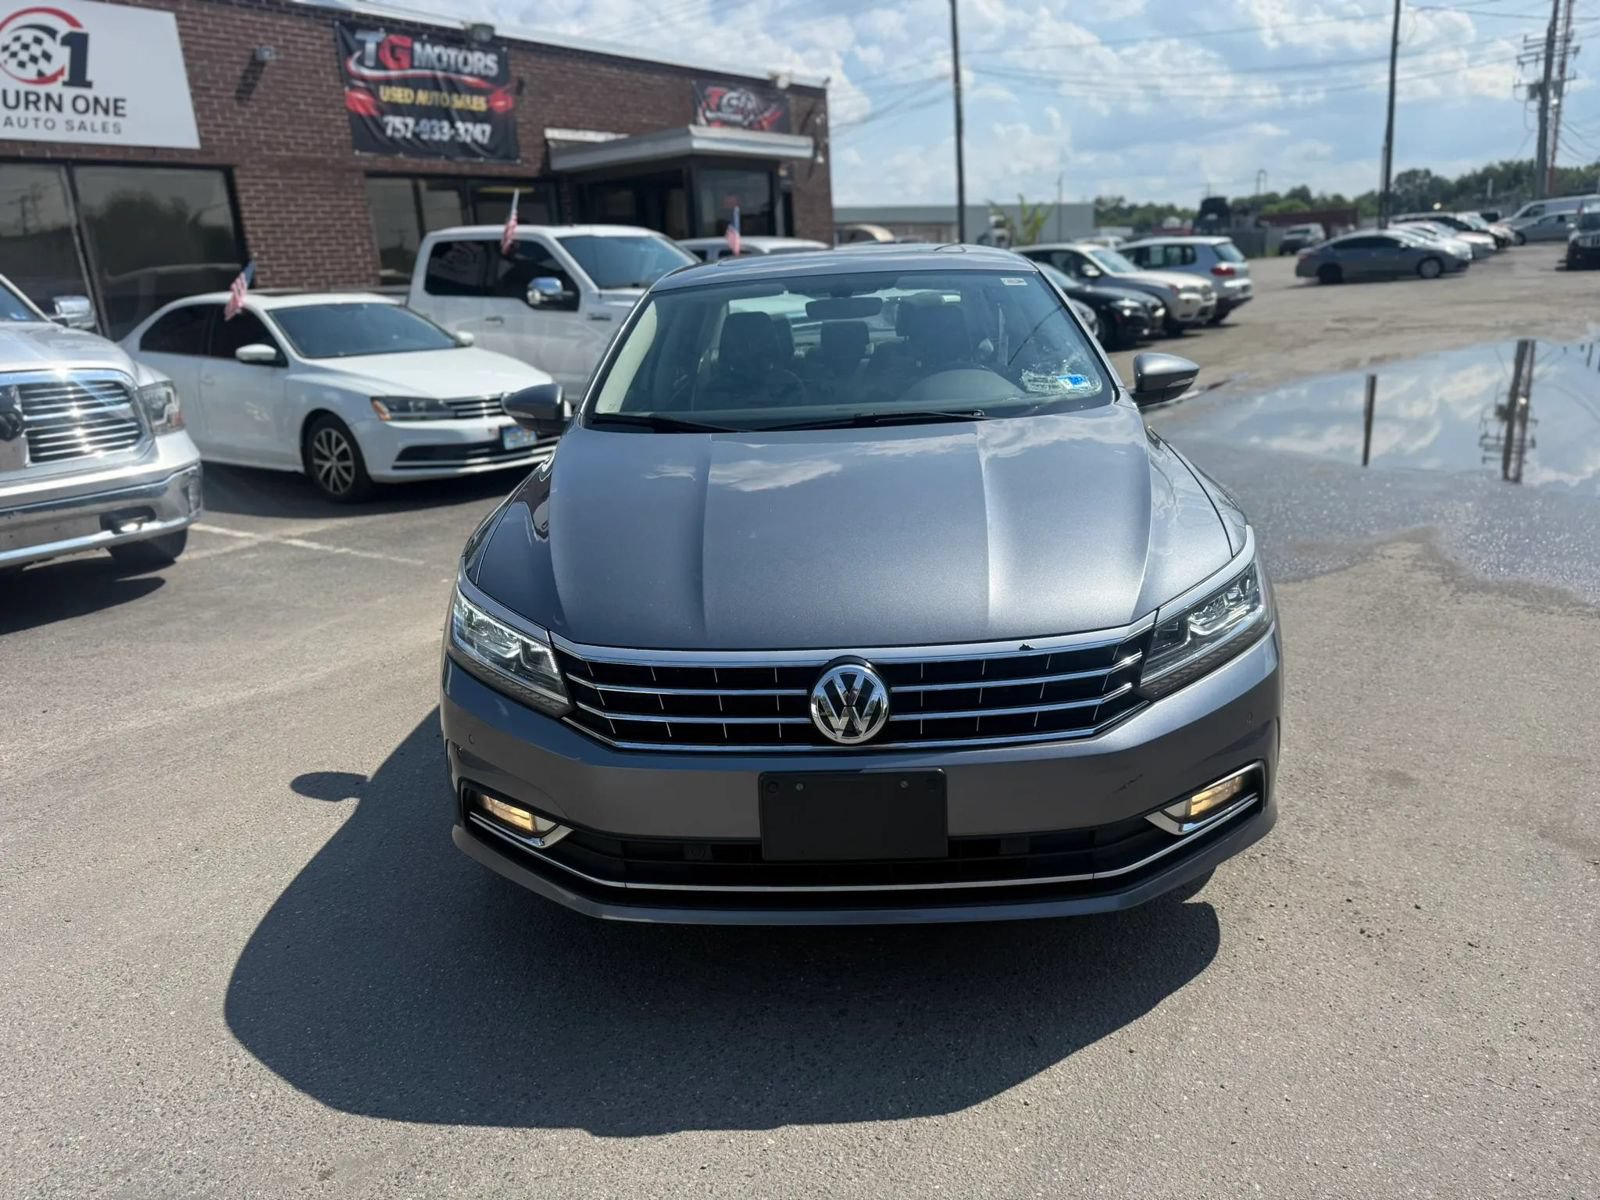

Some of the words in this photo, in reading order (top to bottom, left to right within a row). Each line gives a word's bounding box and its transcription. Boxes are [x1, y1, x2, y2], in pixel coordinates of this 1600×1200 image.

[355, 30, 413, 70] TG
[414, 42, 498, 76] MOTORS
[71, 94, 127, 118] ONE
[380, 86, 414, 104] USED
[415, 89, 449, 108] AUTO
[3, 116, 57, 131] AUTO
[65, 120, 122, 135] SALES
